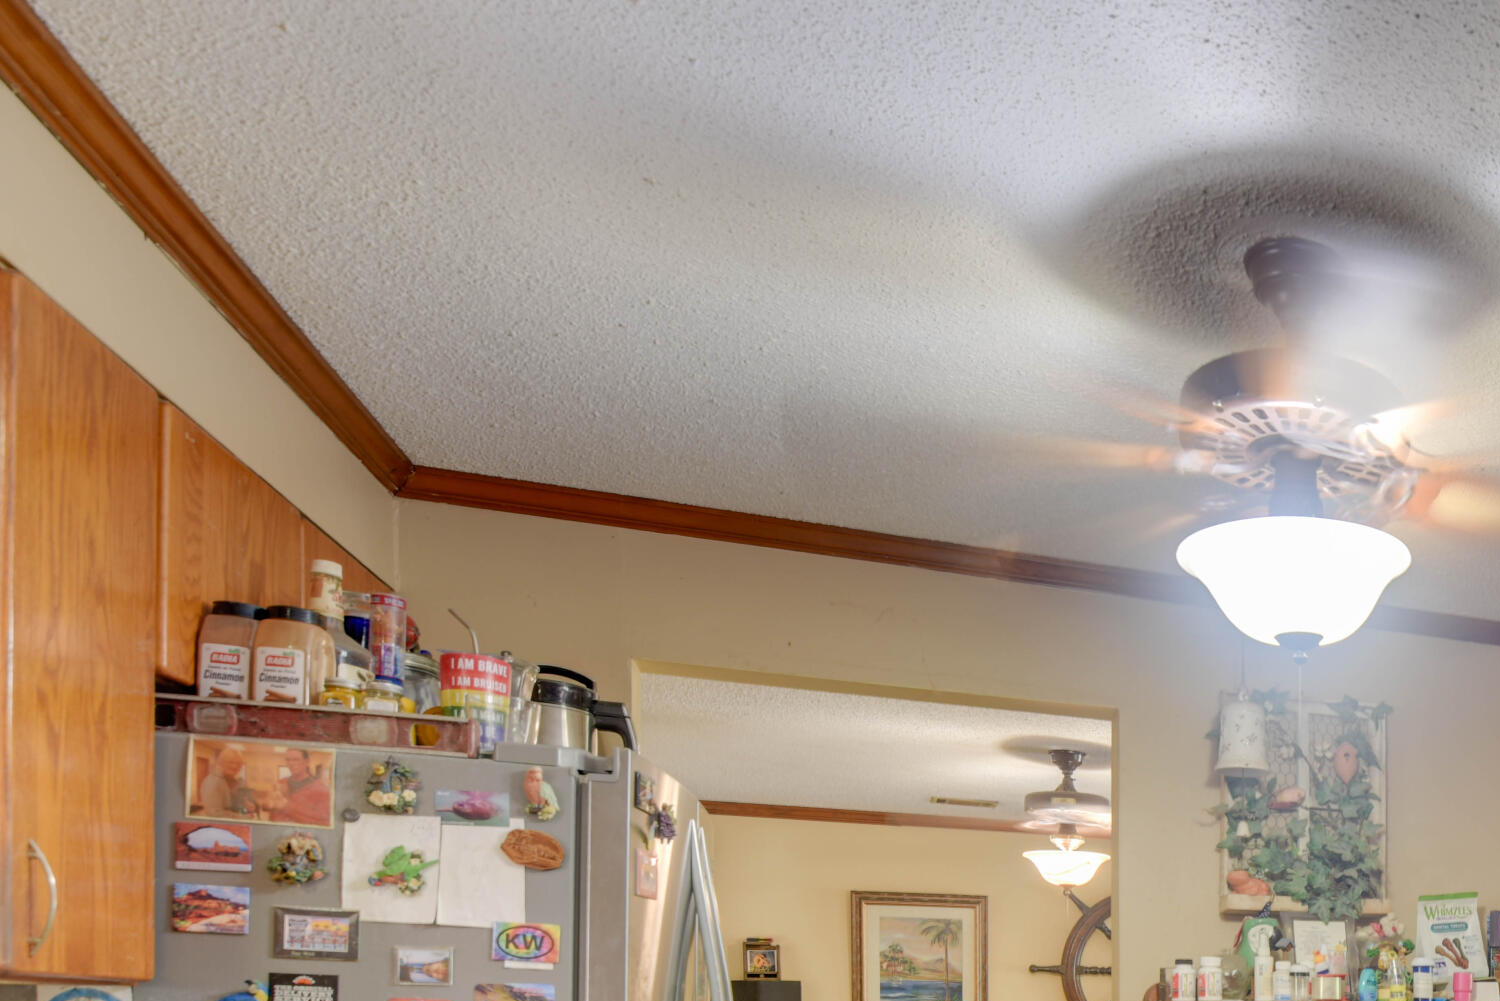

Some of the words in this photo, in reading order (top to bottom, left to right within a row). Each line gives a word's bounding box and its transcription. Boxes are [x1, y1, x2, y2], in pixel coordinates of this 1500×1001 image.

[203, 669, 244, 682] Cinnamon
[457, 658, 474, 670] AM
[478, 659, 508, 678] BRAVE
[259, 672, 300, 685] Cinnamon
[457, 676, 471, 687] AM
[473, 678, 507, 693] BRUISED
[505, 933, 545, 951] KW
